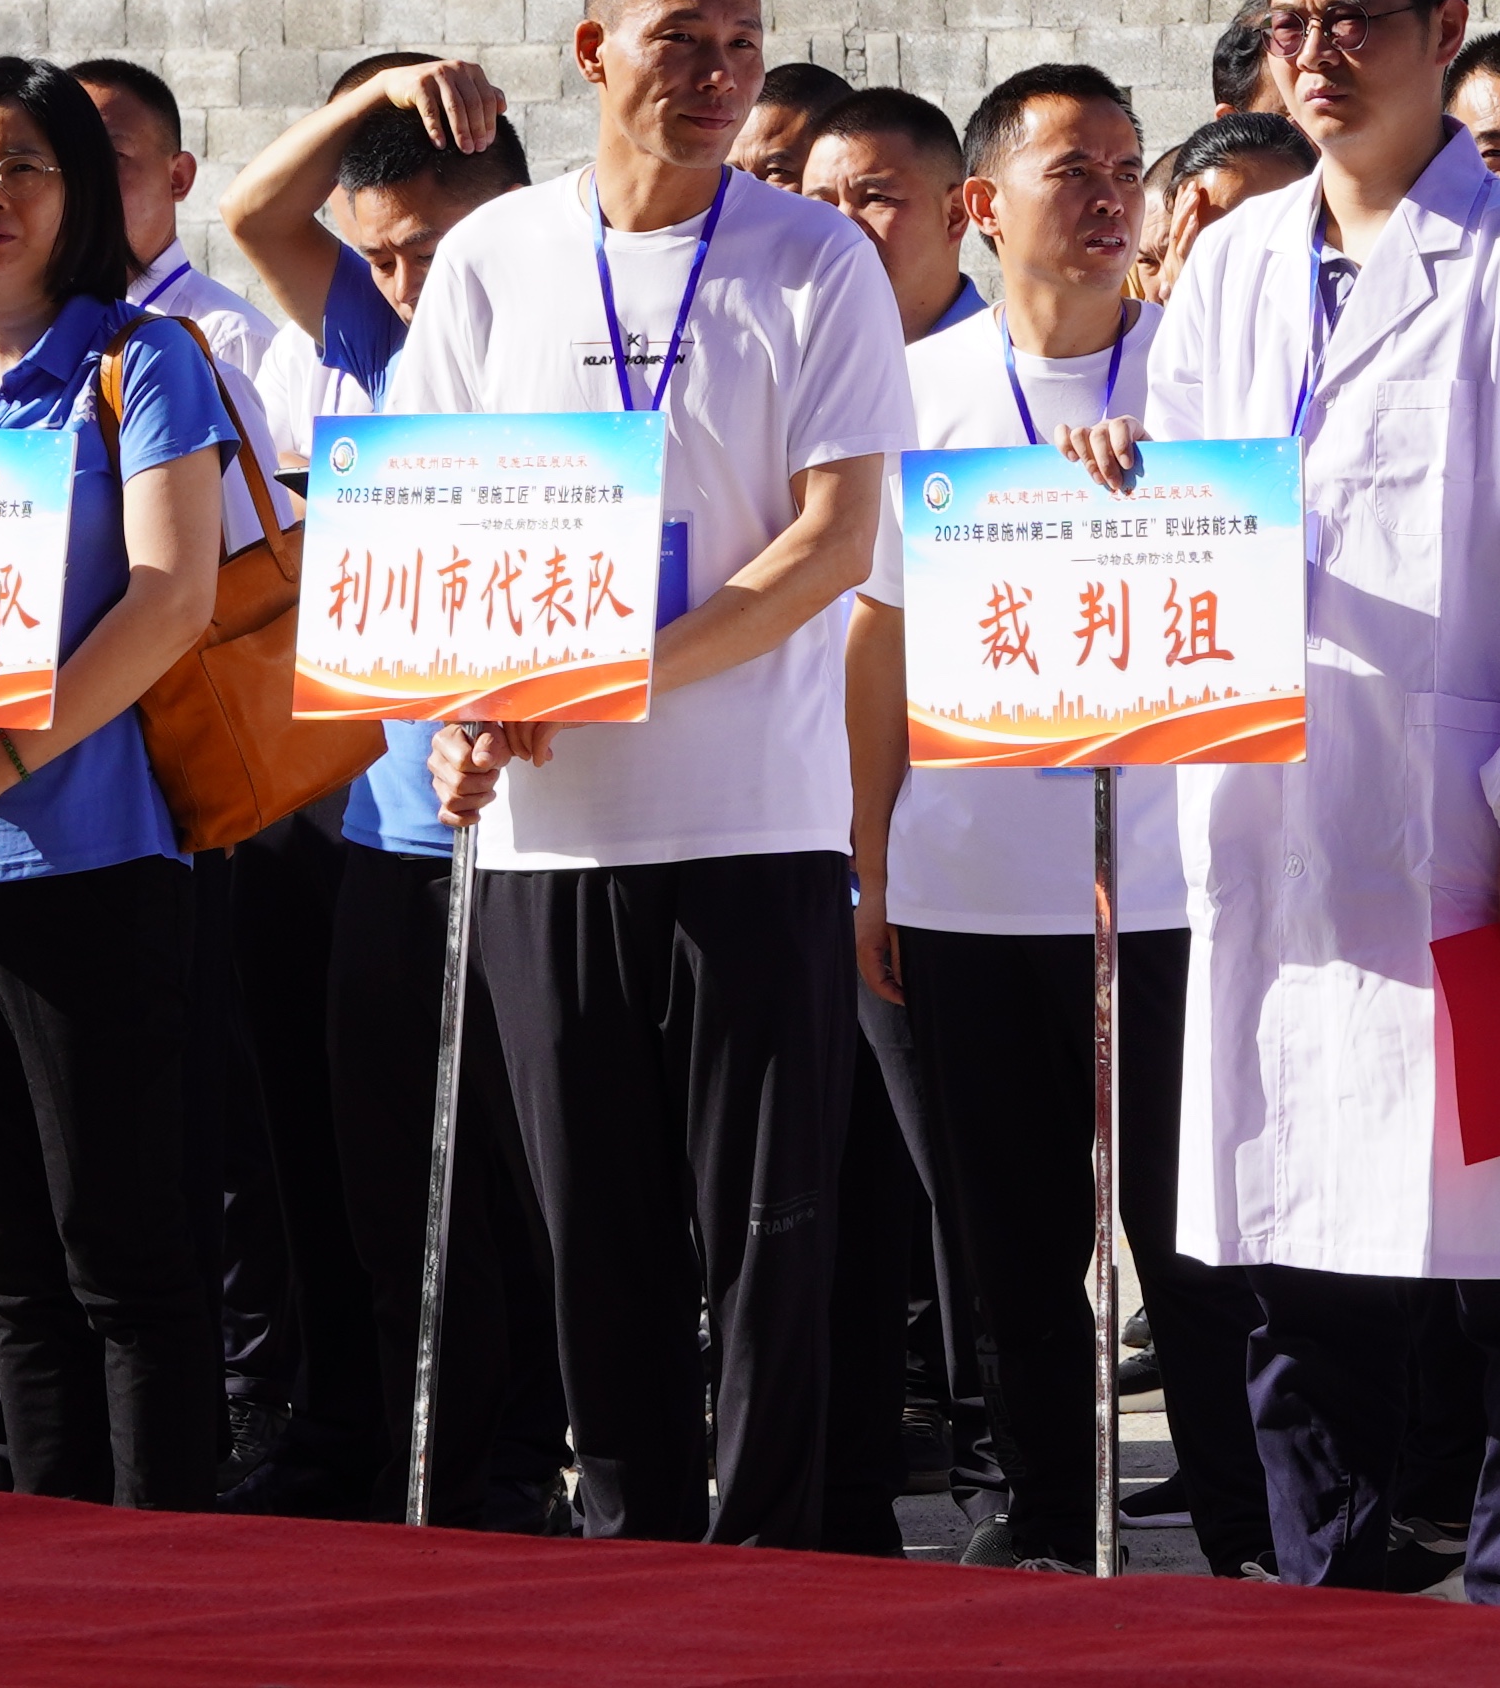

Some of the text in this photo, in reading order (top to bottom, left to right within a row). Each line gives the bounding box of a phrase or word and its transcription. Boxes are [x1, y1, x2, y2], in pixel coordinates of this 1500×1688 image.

[328, 544, 634, 636] 利川市代表队
[978, 578, 1234, 675] 裁判组
